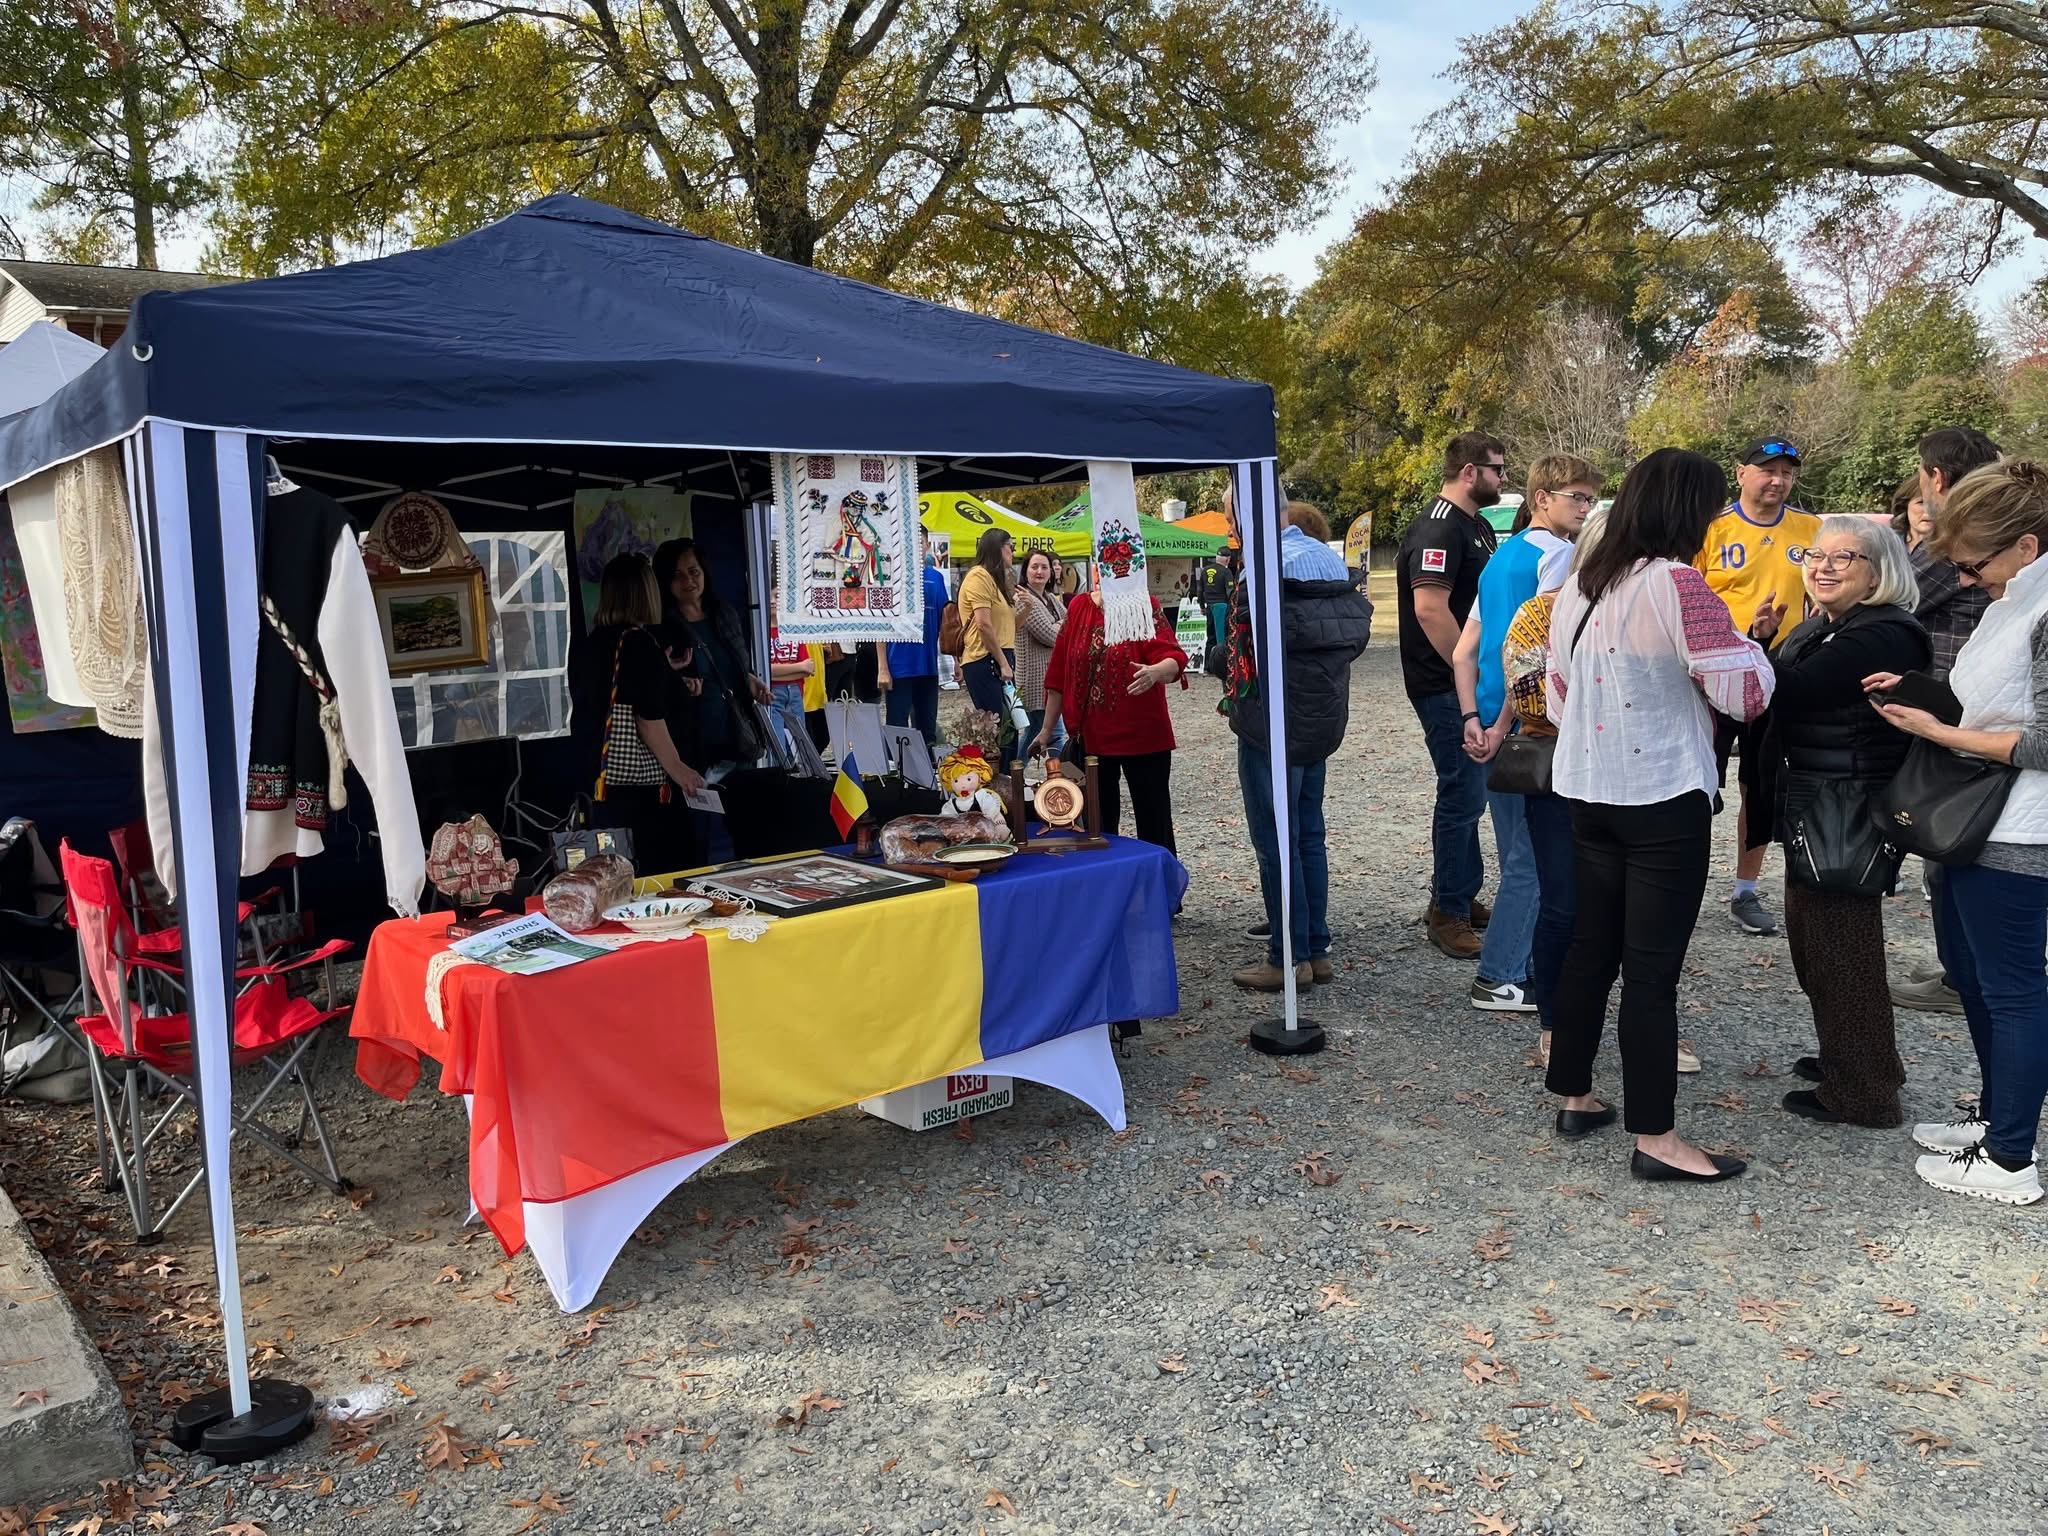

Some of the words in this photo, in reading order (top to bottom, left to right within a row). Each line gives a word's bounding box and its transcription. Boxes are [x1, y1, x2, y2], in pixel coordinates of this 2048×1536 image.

[1351, 527, 1370, 539] LOCAL
[1021, 537, 1055, 552] FIBER
[1172, 540, 1209, 550] ANDERSEN
[1720, 542, 1746, 569] 10
[1177, 632, 1205, 642] $15,000
[961, 1090, 1010, 1117] ORCHARD
[922, 1103, 958, 1127] FRESH
